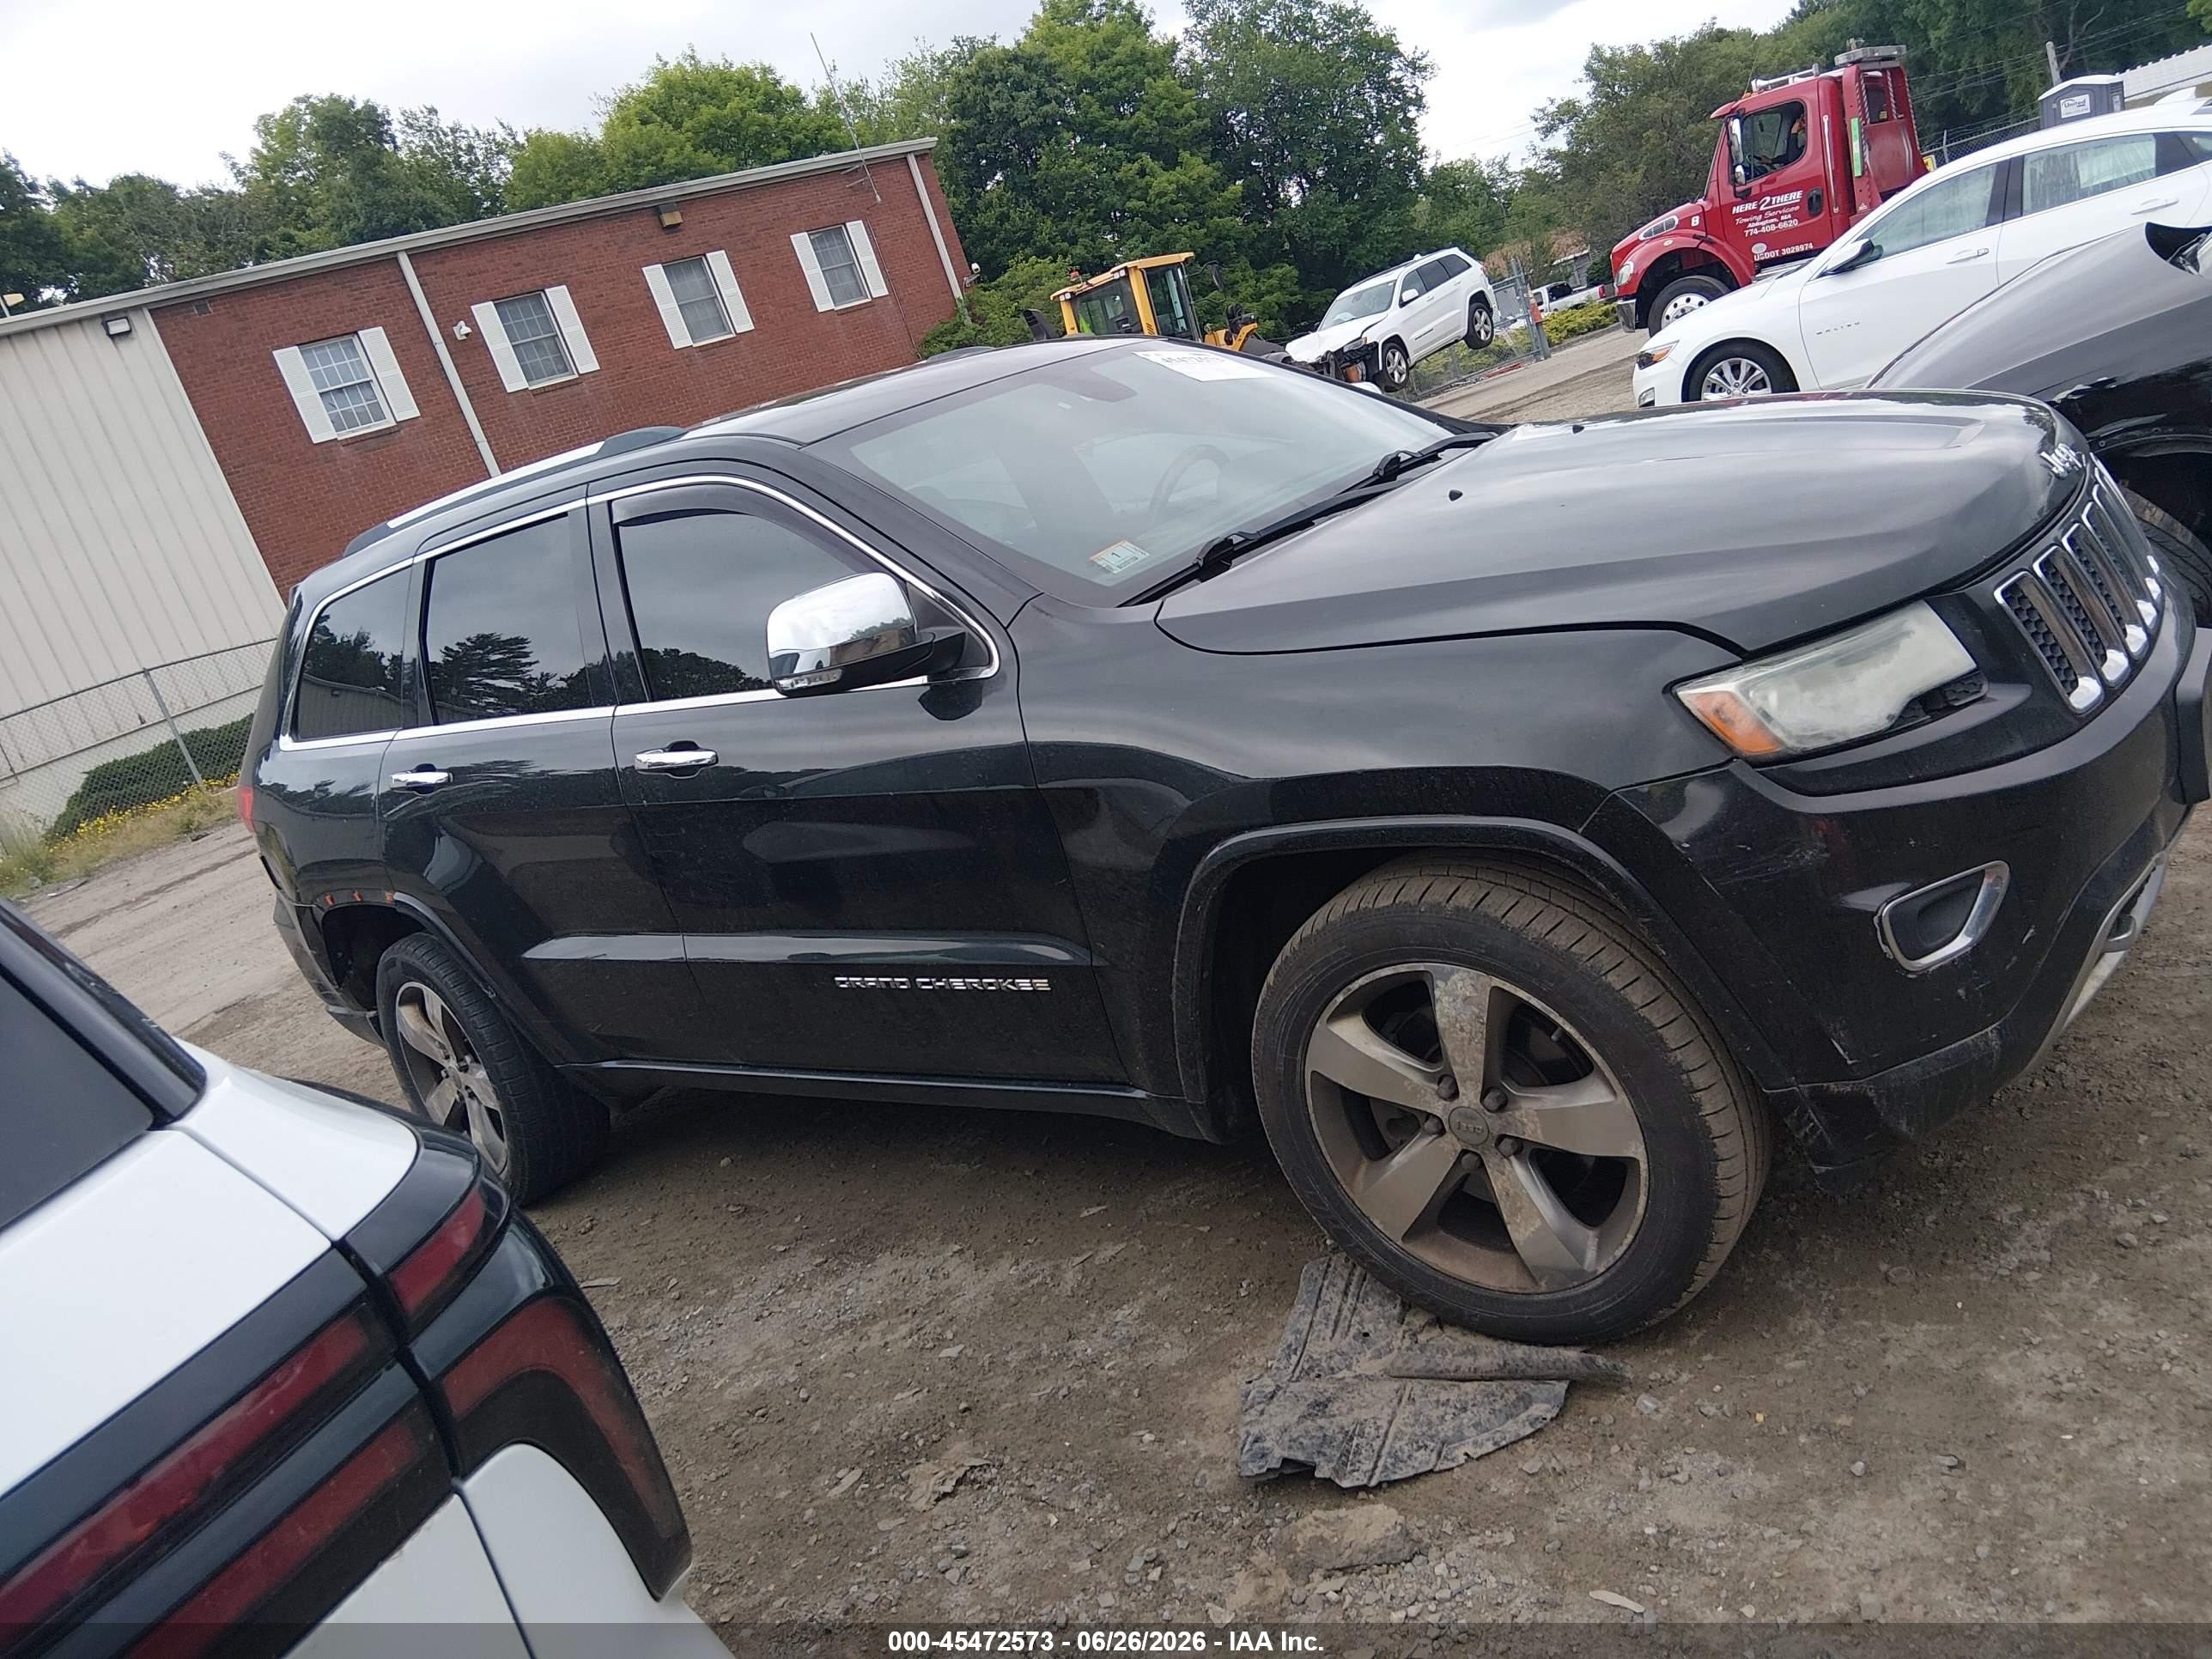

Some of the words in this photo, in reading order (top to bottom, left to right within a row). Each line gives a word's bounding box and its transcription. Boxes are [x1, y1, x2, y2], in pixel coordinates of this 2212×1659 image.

[1732, 201, 1758, 214] HERE
[1759, 197, 1771, 211] 2
[1771, 190, 1803, 204] THERE
[1735, 215, 1762, 225] Towing
[1764, 205, 1801, 219] Services
[1753, 250, 1779, 261] USDOT
[834, 976, 911, 989] GRAND
[915, 977, 1051, 992] CHEROKEE
